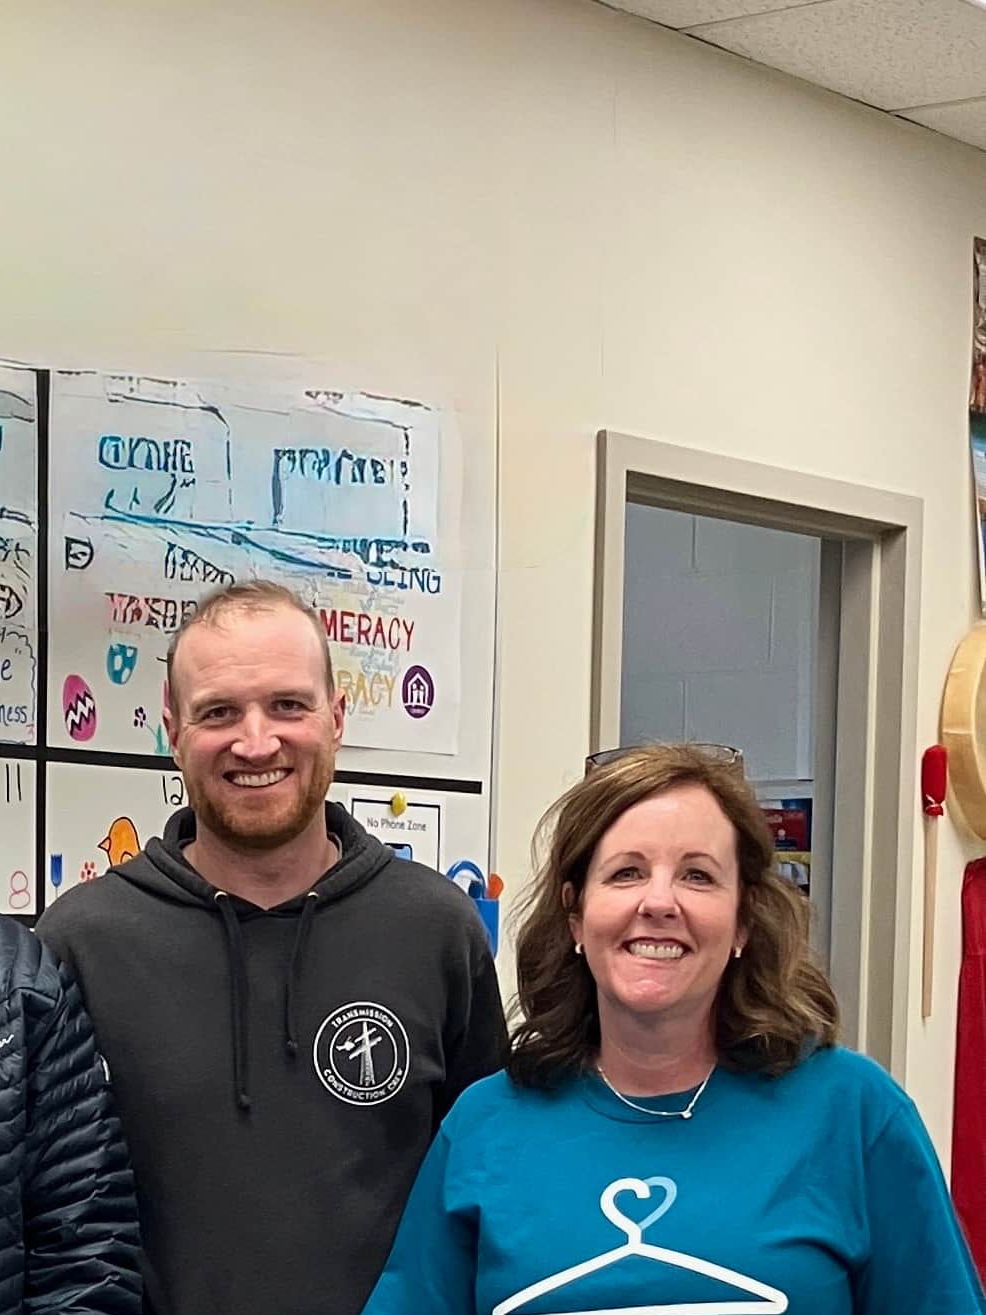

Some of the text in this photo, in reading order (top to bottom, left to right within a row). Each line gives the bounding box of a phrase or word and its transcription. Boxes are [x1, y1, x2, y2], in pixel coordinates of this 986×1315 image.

[319, 608, 414, 651] MERACY
[6, 763, 22, 803] 11
[162, 775, 184, 806] 12
[367, 817, 427, 831] No Phone Zone
[9, 870, 31, 910] 8
[331, 1008, 394, 1028] TRANSMISSION
[323, 1068, 386, 1100] CONSTRUCTION
